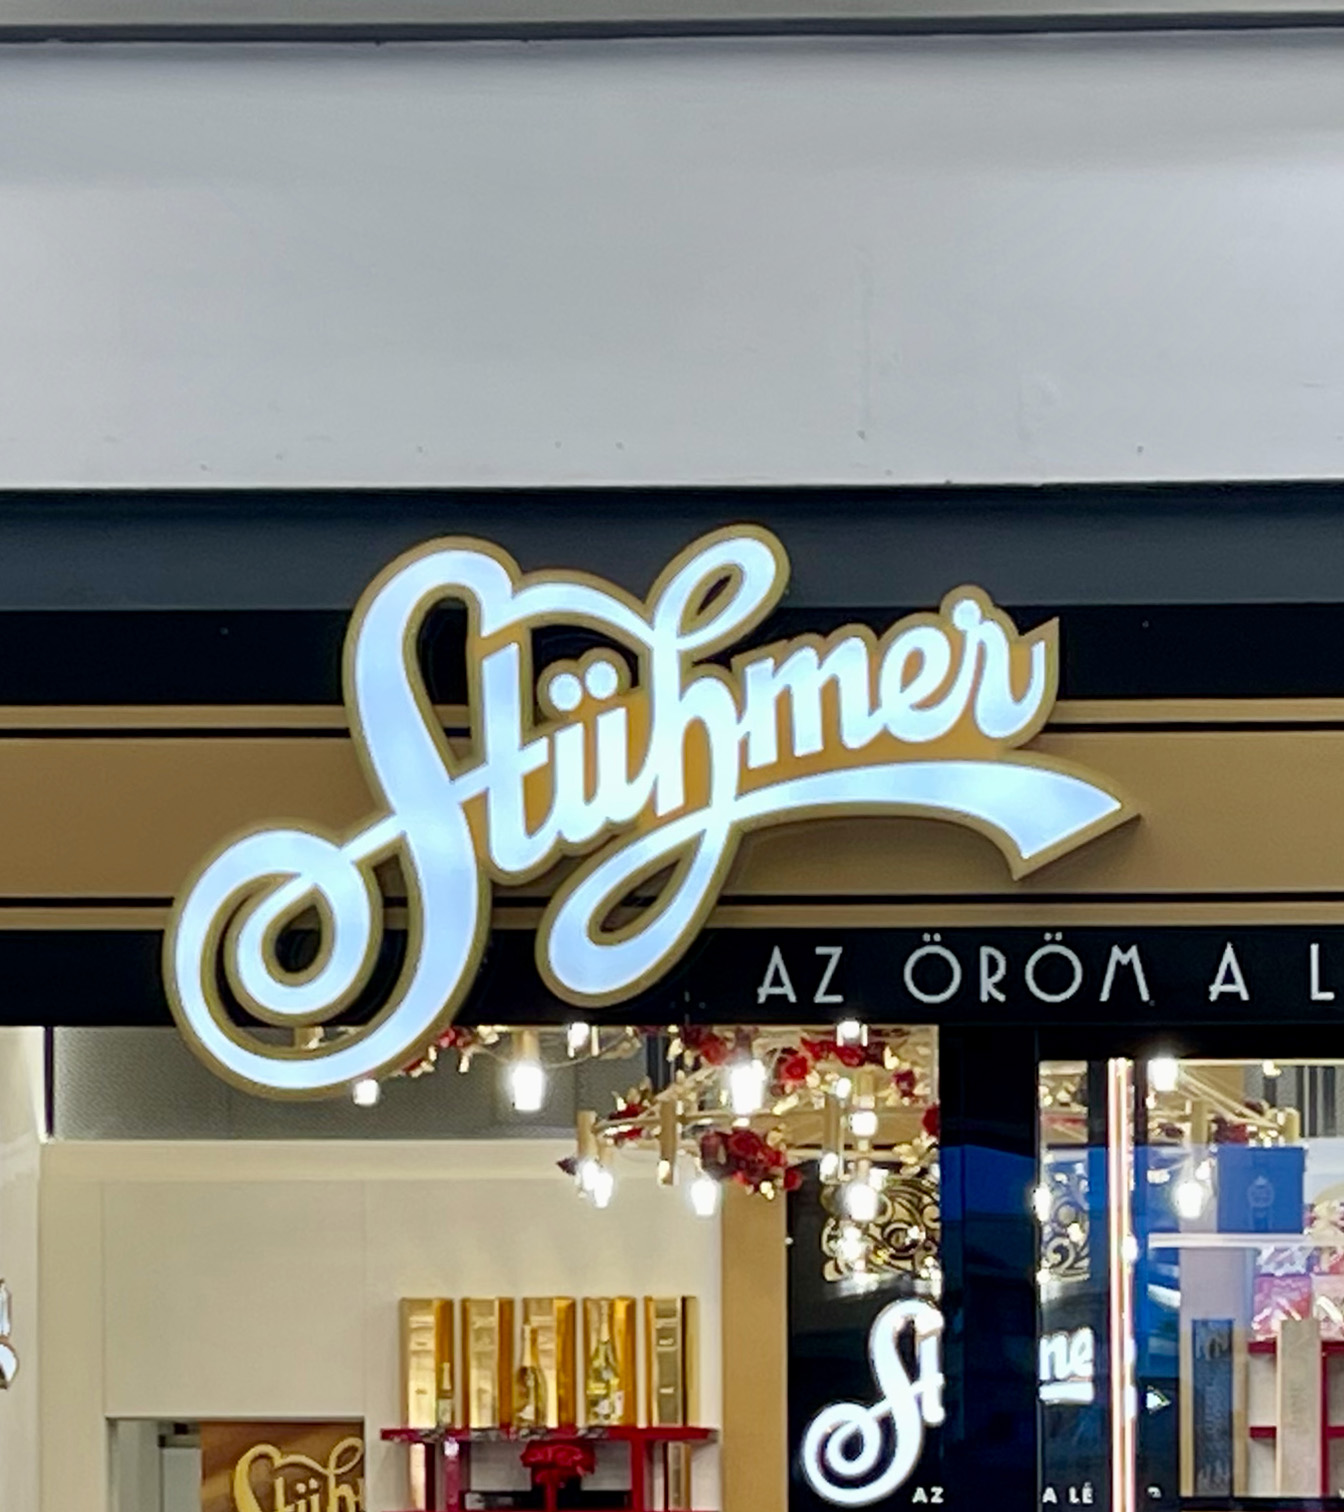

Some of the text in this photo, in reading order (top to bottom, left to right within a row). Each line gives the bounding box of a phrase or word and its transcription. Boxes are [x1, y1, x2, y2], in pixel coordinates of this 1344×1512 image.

[166, 526, 1134, 1096] Stühmer
[756, 945, 845, 1004] AZ
[903, 932, 1152, 1004] ÖRÖM
[1208, 942, 1251, 1001] A
[911, 1486, 945, 1504] AZ
